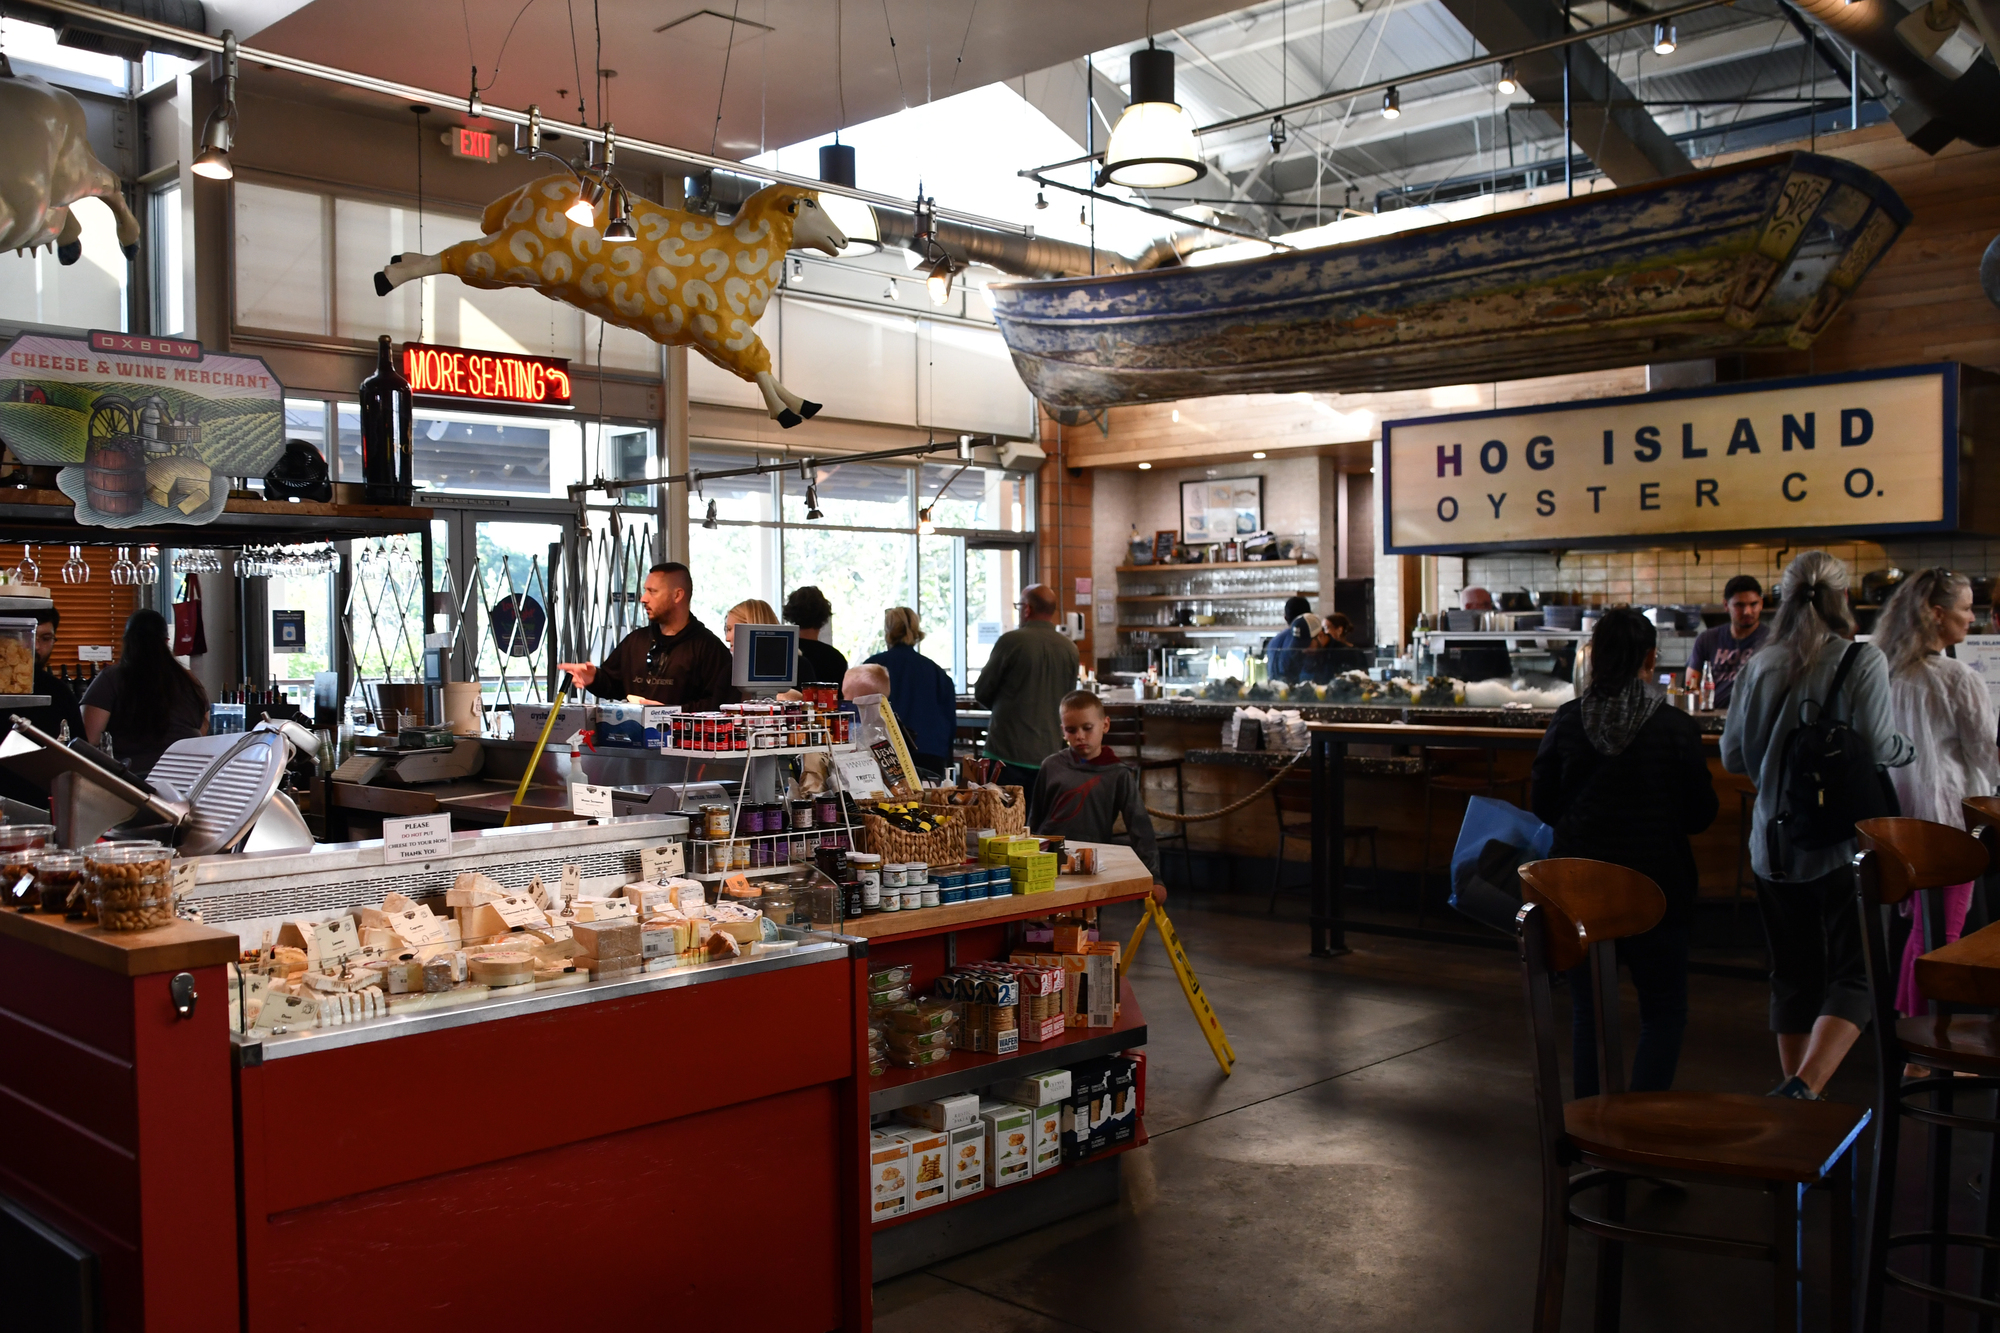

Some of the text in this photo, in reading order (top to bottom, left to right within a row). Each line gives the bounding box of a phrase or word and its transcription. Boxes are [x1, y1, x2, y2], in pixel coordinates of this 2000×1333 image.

[461, 129, 491, 158] EXIT
[102, 337, 192, 355] OXBOW
[11, 352, 269, 389] CHEESE & WINE MERCHANT
[410, 349, 545, 400] MORE SEATING
[1436, 407, 1875, 478] HOG ISLAND
[1436, 468, 1884, 522] OYSTER CO.
[1714, 648, 1754, 665] HOG
[404, 822, 430, 830] PLEASE
[999, 1036, 1018, 1047] WAFER
[999, 1045, 1018, 1053] CRACKERS
